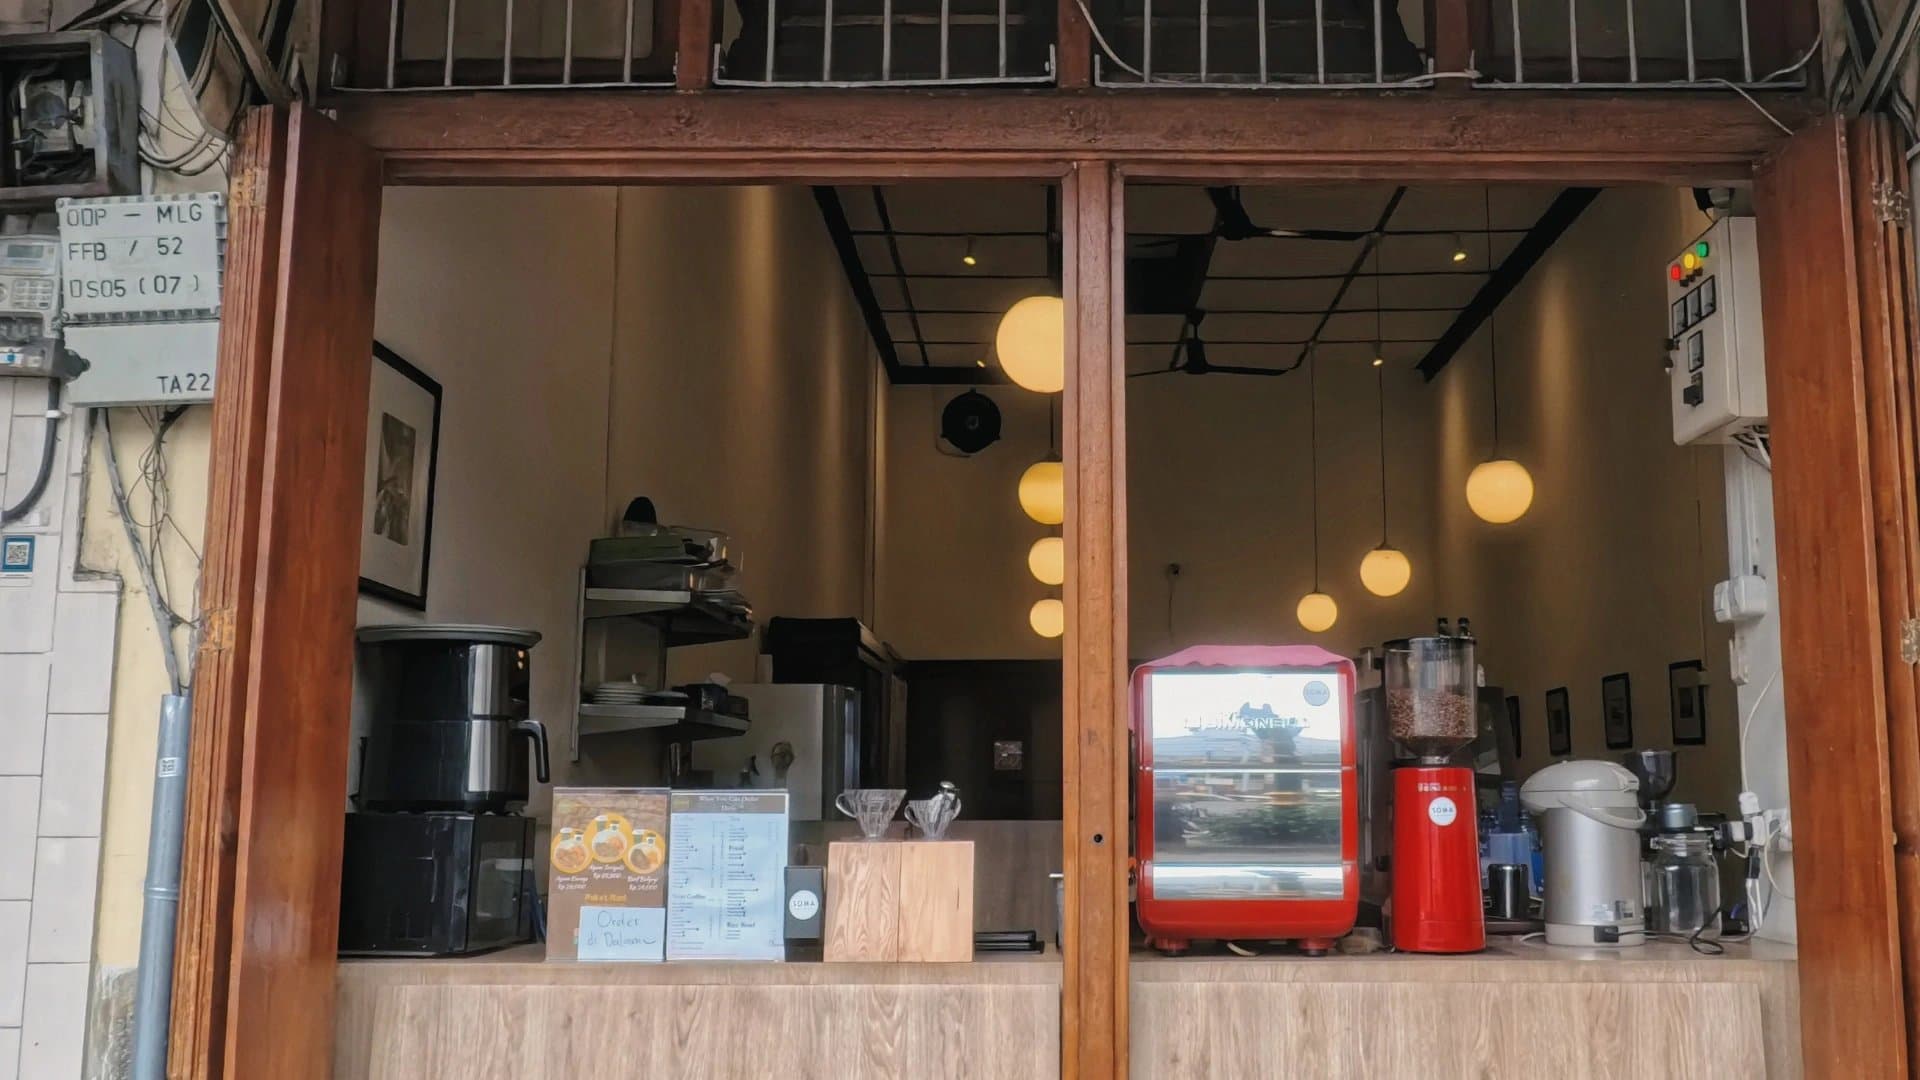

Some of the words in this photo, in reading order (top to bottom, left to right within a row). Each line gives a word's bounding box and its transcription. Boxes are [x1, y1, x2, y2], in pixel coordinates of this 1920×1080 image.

[67, 208, 107, 227] ODP
[157, 203, 202, 224] MLG
[68, 242, 107, 261] FFB
[129, 240, 138, 256] /
[157, 236, 183, 255] 52
[156, 373, 211, 393] TA22
